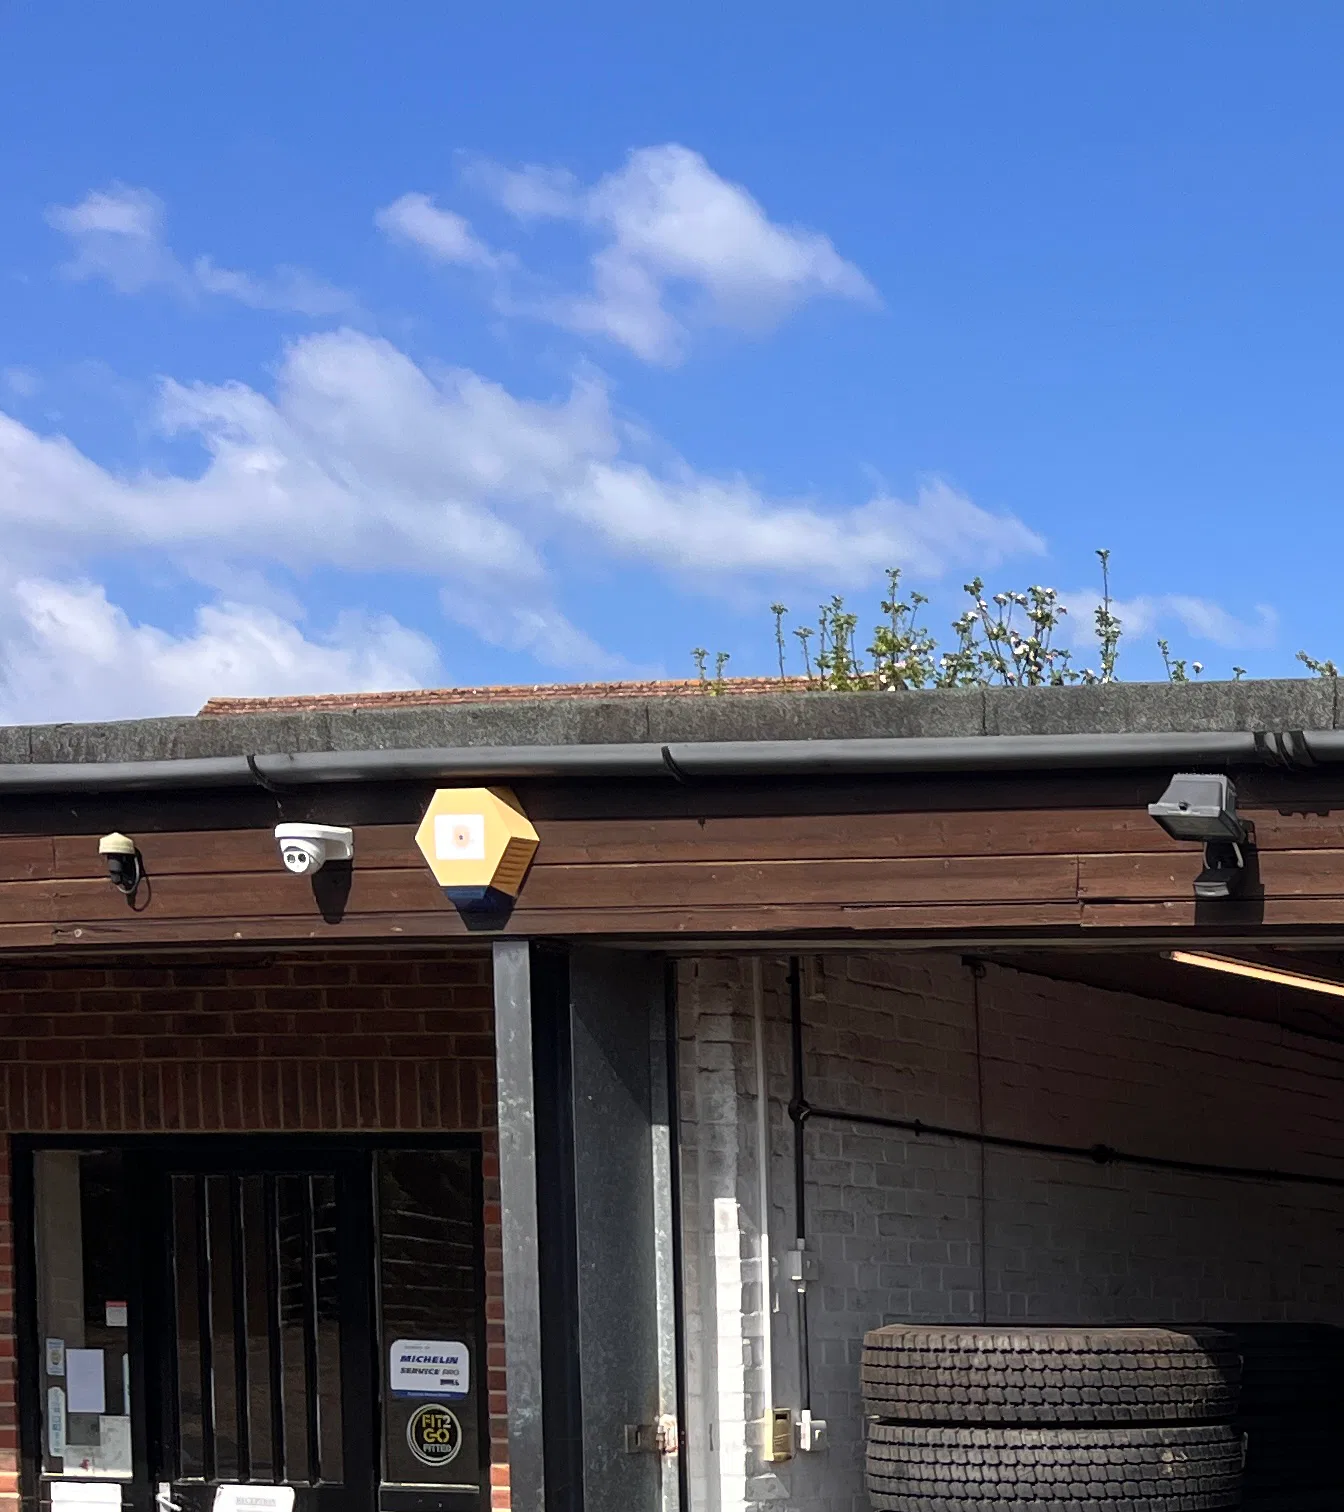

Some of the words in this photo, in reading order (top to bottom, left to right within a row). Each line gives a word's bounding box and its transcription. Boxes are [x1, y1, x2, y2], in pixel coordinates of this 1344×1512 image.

[400, 1355, 458, 1364] MICHELIN
[400, 1367, 440, 1375] SERVICE
[421, 1414, 452, 1428] FIT2
[423, 1429, 450, 1443] GO
